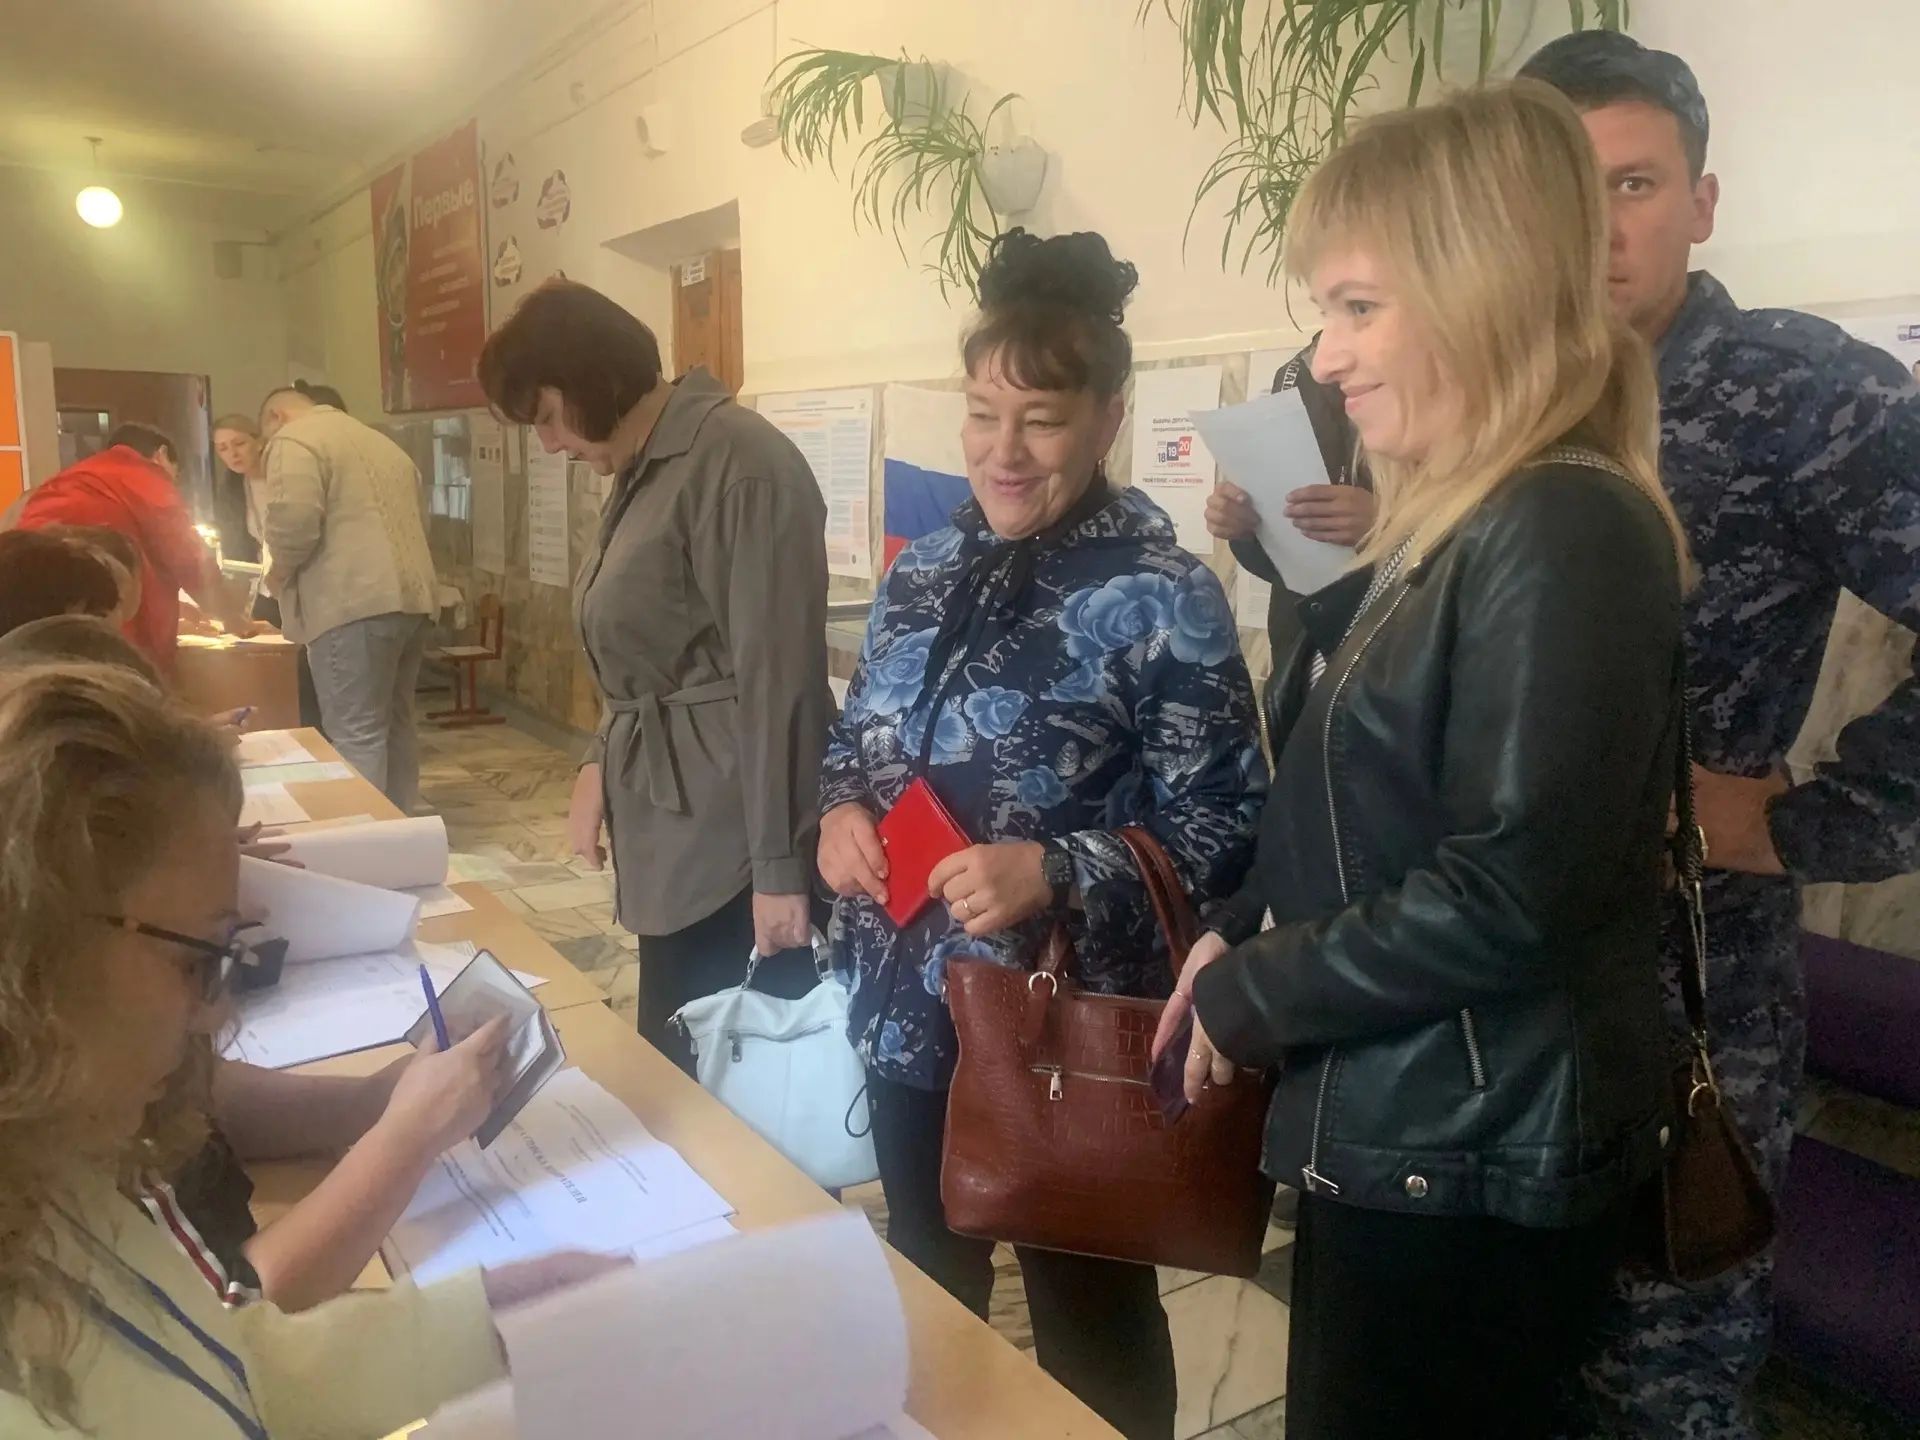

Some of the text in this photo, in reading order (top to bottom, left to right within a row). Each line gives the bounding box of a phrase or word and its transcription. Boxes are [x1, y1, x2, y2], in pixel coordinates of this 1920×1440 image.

[413, 178, 475, 230] Первые
[1158, 452, 1166, 463] 18
[1168, 446, 1177, 457] 19
[1179, 440, 1190, 452] 20
